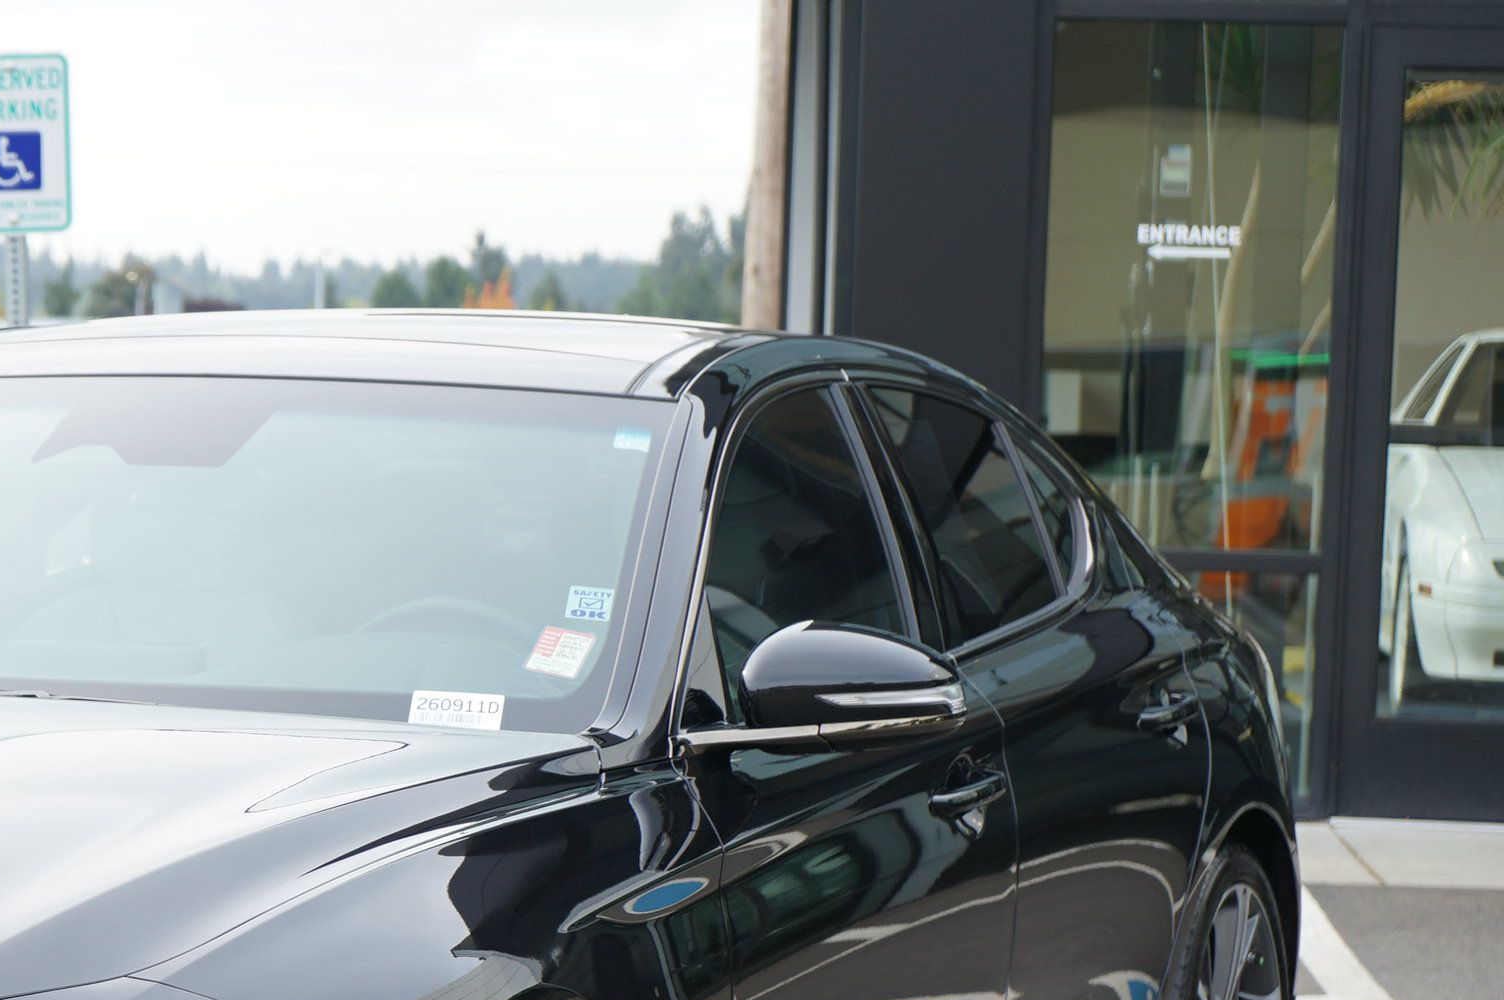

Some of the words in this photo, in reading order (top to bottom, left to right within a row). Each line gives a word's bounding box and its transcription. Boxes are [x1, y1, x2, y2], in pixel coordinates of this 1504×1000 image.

[1137, 223, 1242, 246] ENTRANCE
[573, 589, 612, 598] SAFETY
[570, 609, 606, 619] OK
[416, 697, 500, 714] 260911D
